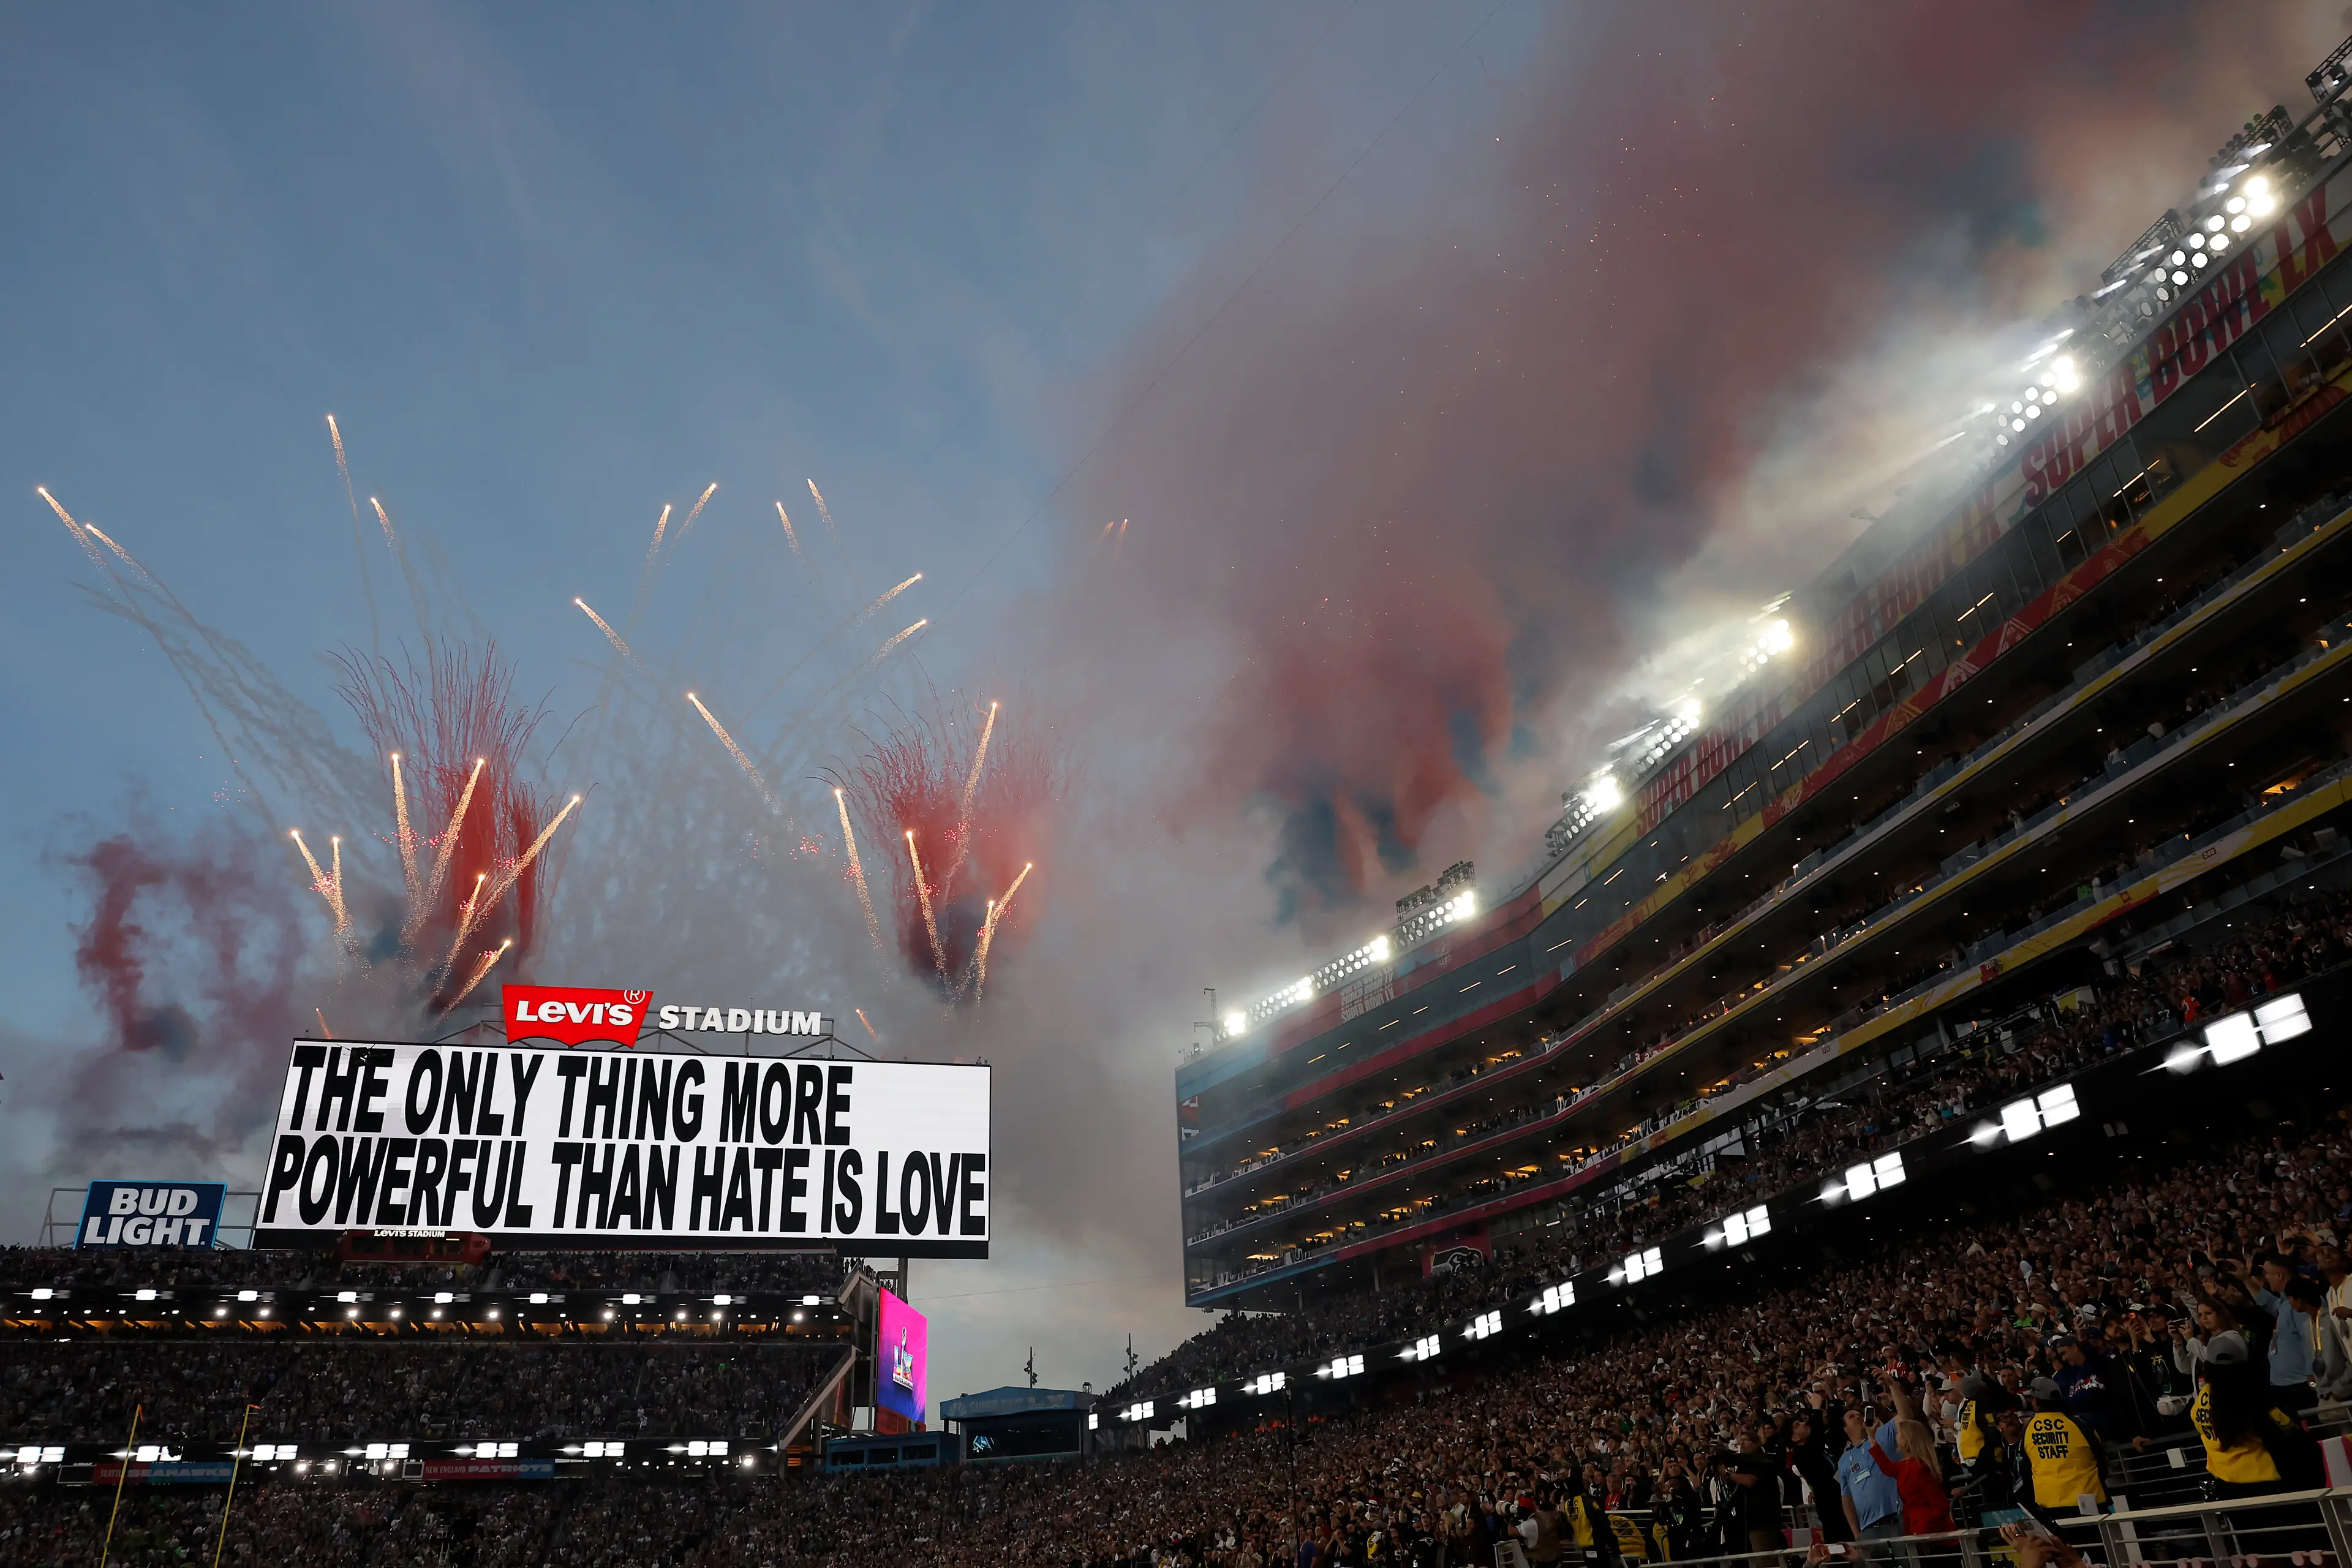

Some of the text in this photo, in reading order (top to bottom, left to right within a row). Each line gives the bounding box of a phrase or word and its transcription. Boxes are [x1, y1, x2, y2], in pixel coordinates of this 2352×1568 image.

[2021, 183, 2339, 507] SUPER BOWL LX
[1877, 529, 1951, 631] BOWL
[1635, 755, 1693, 838] SUPER
[1696, 706, 1753, 790] BOWL
[2203, 848, 2215, 859] 240
[658, 1005, 821, 1035] STADIUM
[290, 1045, 853, 1145] THE ONLY THING MORE
[262, 1134, 986, 1236] POWERFUL THAN HATE IS LOVE
[108, 1188, 198, 1216] BUD
[84, 1216, 210, 1245] LIGHT
[2031, 1431, 2069, 1445] SECURITY
[2034, 1419, 2065, 1431] CSC
[2038, 1445, 2069, 1459] STAFF
[127, 1468, 232, 1477] SEAHAWKS
[439, 1465, 466, 1474] ENGLAND
[468, 1464, 551, 1473] PATRIOTS
